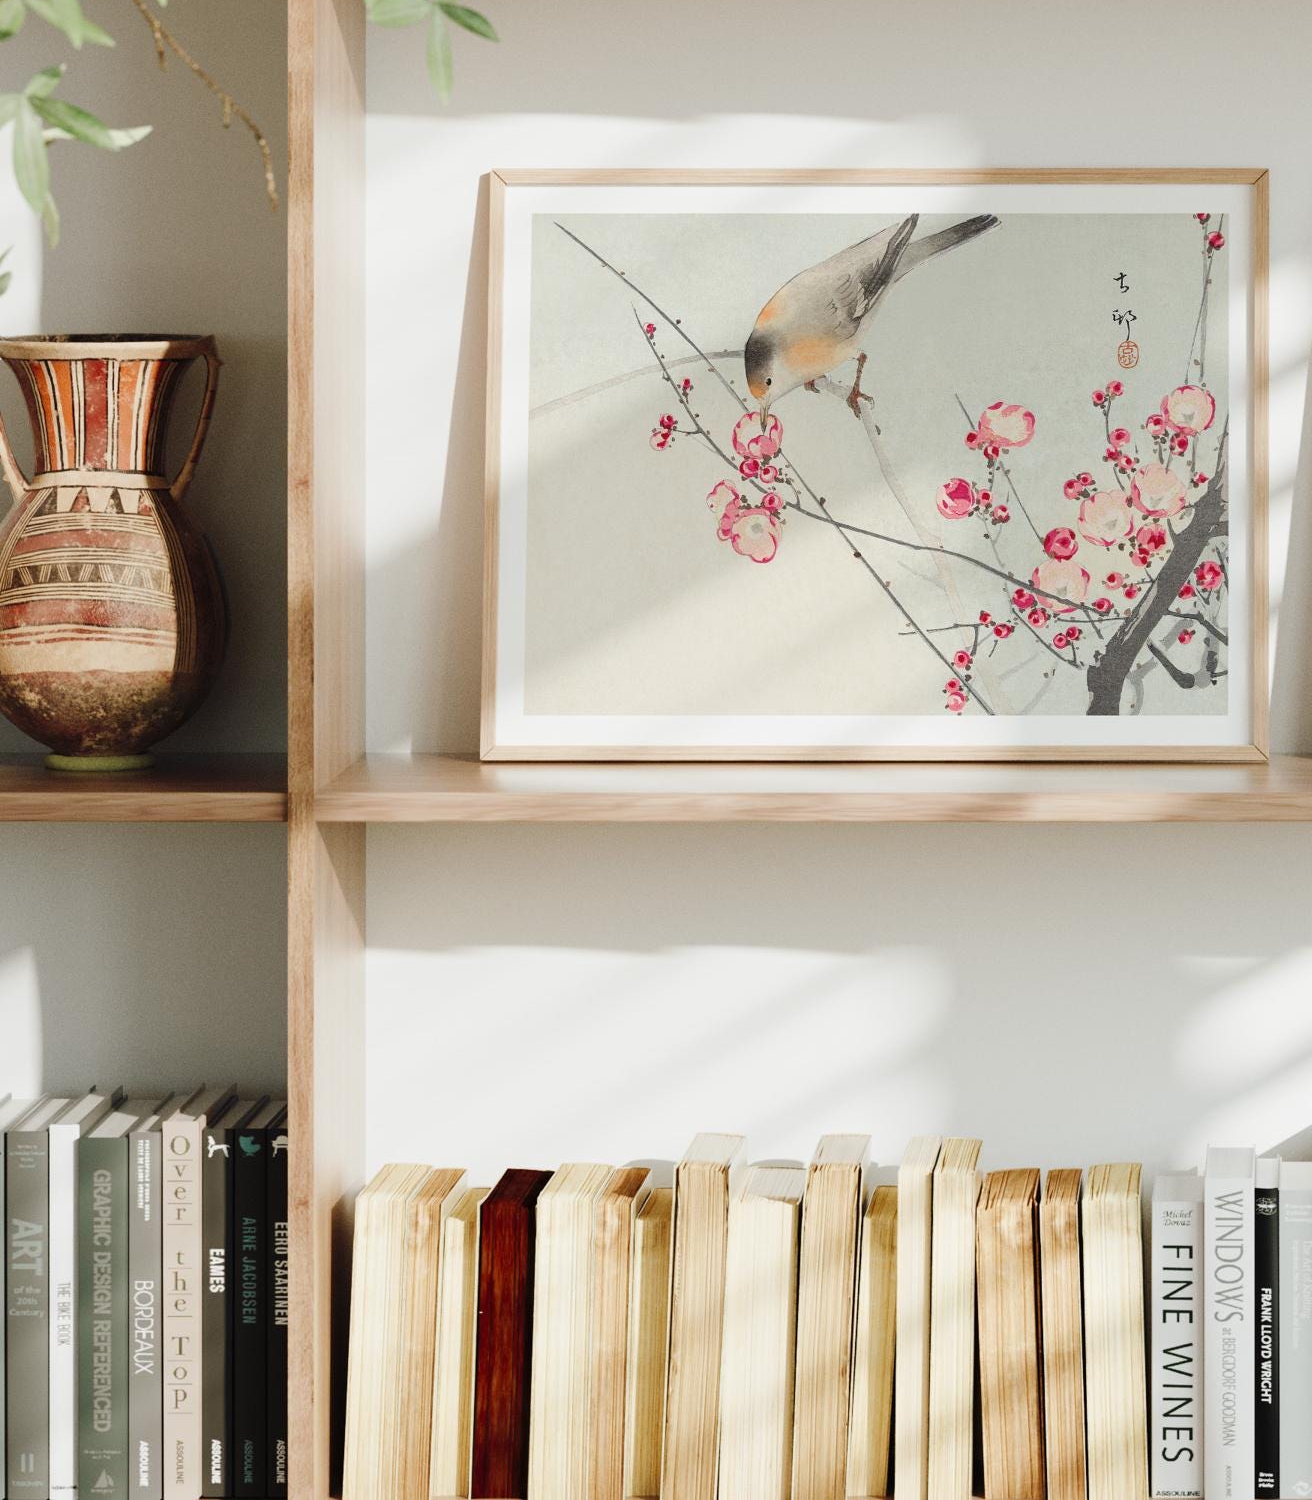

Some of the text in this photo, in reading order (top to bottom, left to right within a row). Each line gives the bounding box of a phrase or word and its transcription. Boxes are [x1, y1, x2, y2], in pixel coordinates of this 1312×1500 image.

[92, 1169, 111, 1246] GRAPHIC
[11, 1219, 43, 1276] ART
[209, 1248, 225, 1293] EAMES
[242, 1217, 256, 1324] ARNE JACOBSEN
[274, 1221, 288, 1326] EERO SAARINEN
[9, 1308, 44, 1319] Century
[56, 1282, 71, 1346] THE BIKE BOOK
[92, 1251, 111, 1314] DESIGN
[134, 1280, 154, 1375] BORDEAUX
[1214, 1190, 1244, 1446] WINDOWS at BERGDORF GOODMAN
[1260, 1288, 1272, 1404] FRANK LLOYD WRIGHT
[92, 1320, 111, 1433] REFERENCED
[1162, 1244, 1194, 1462] FINE WINES
[138, 1440, 149, 1487] ASSOULINE
[176, 1440, 184, 1484] ASSOULINE
[211, 1439, 222, 1484] ASSOULINE
[244, 1439, 253, 1484] ASSOULINE
[276, 1439, 286, 1484] ASSOULINE
